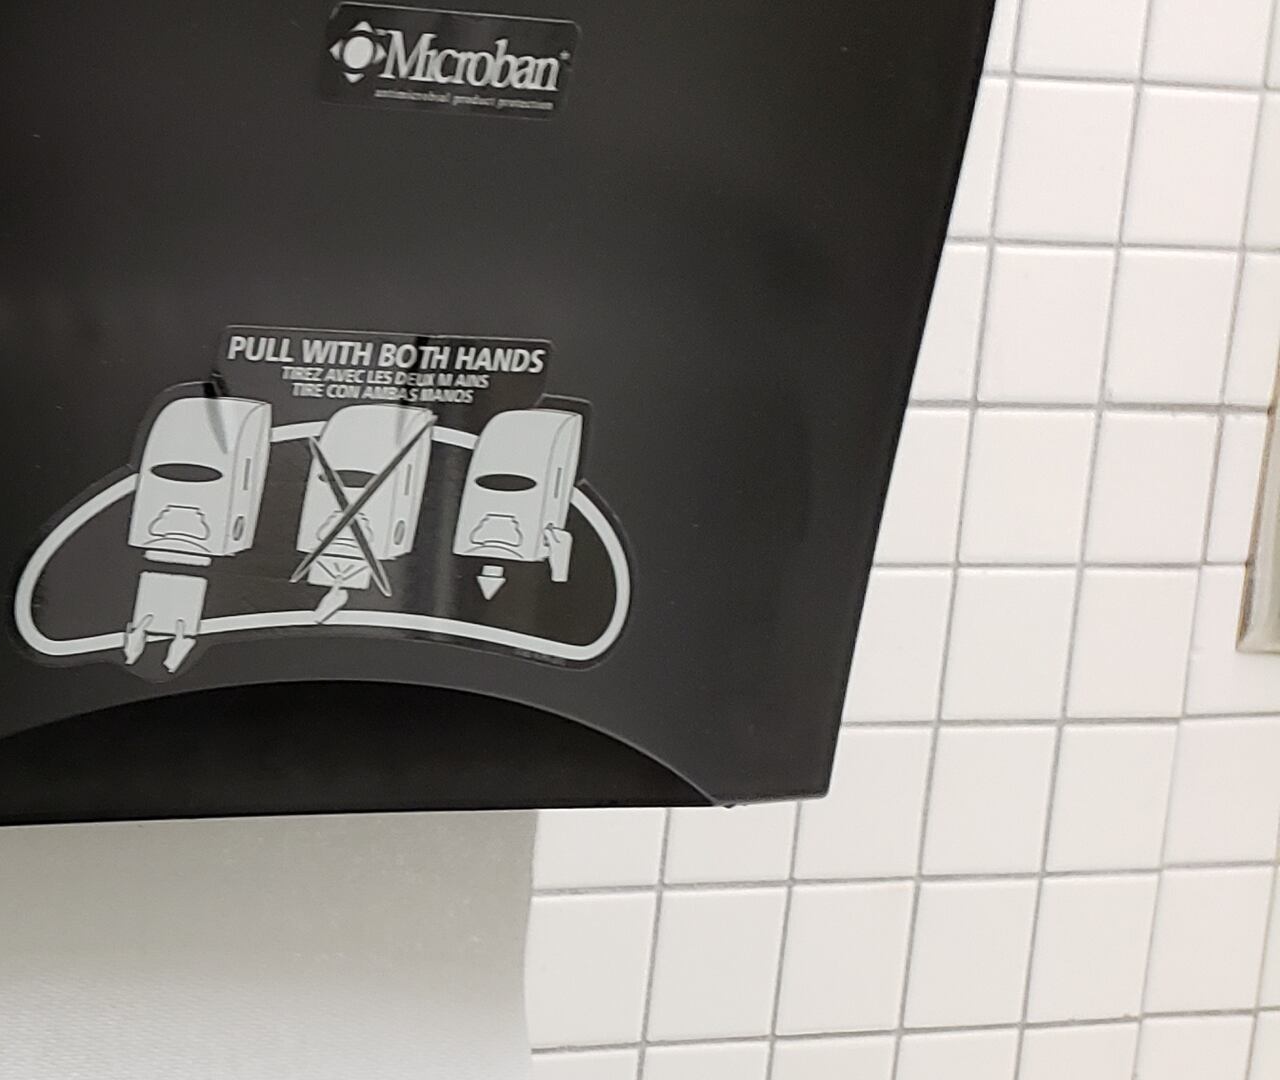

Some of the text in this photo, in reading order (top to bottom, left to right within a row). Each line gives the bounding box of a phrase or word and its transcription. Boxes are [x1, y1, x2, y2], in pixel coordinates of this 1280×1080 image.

[375, 28, 560, 92] Microban
[226, 335, 546, 374] PULL WITH BOTH HANDS
[281, 366, 324, 382] TIREZ
[324, 368, 365, 384] AVEC
[366, 370, 393, 386] LES
[394, 371, 435, 388] DEUX
[292, 382, 475, 404] TIRE CON AMBAS MANOS
